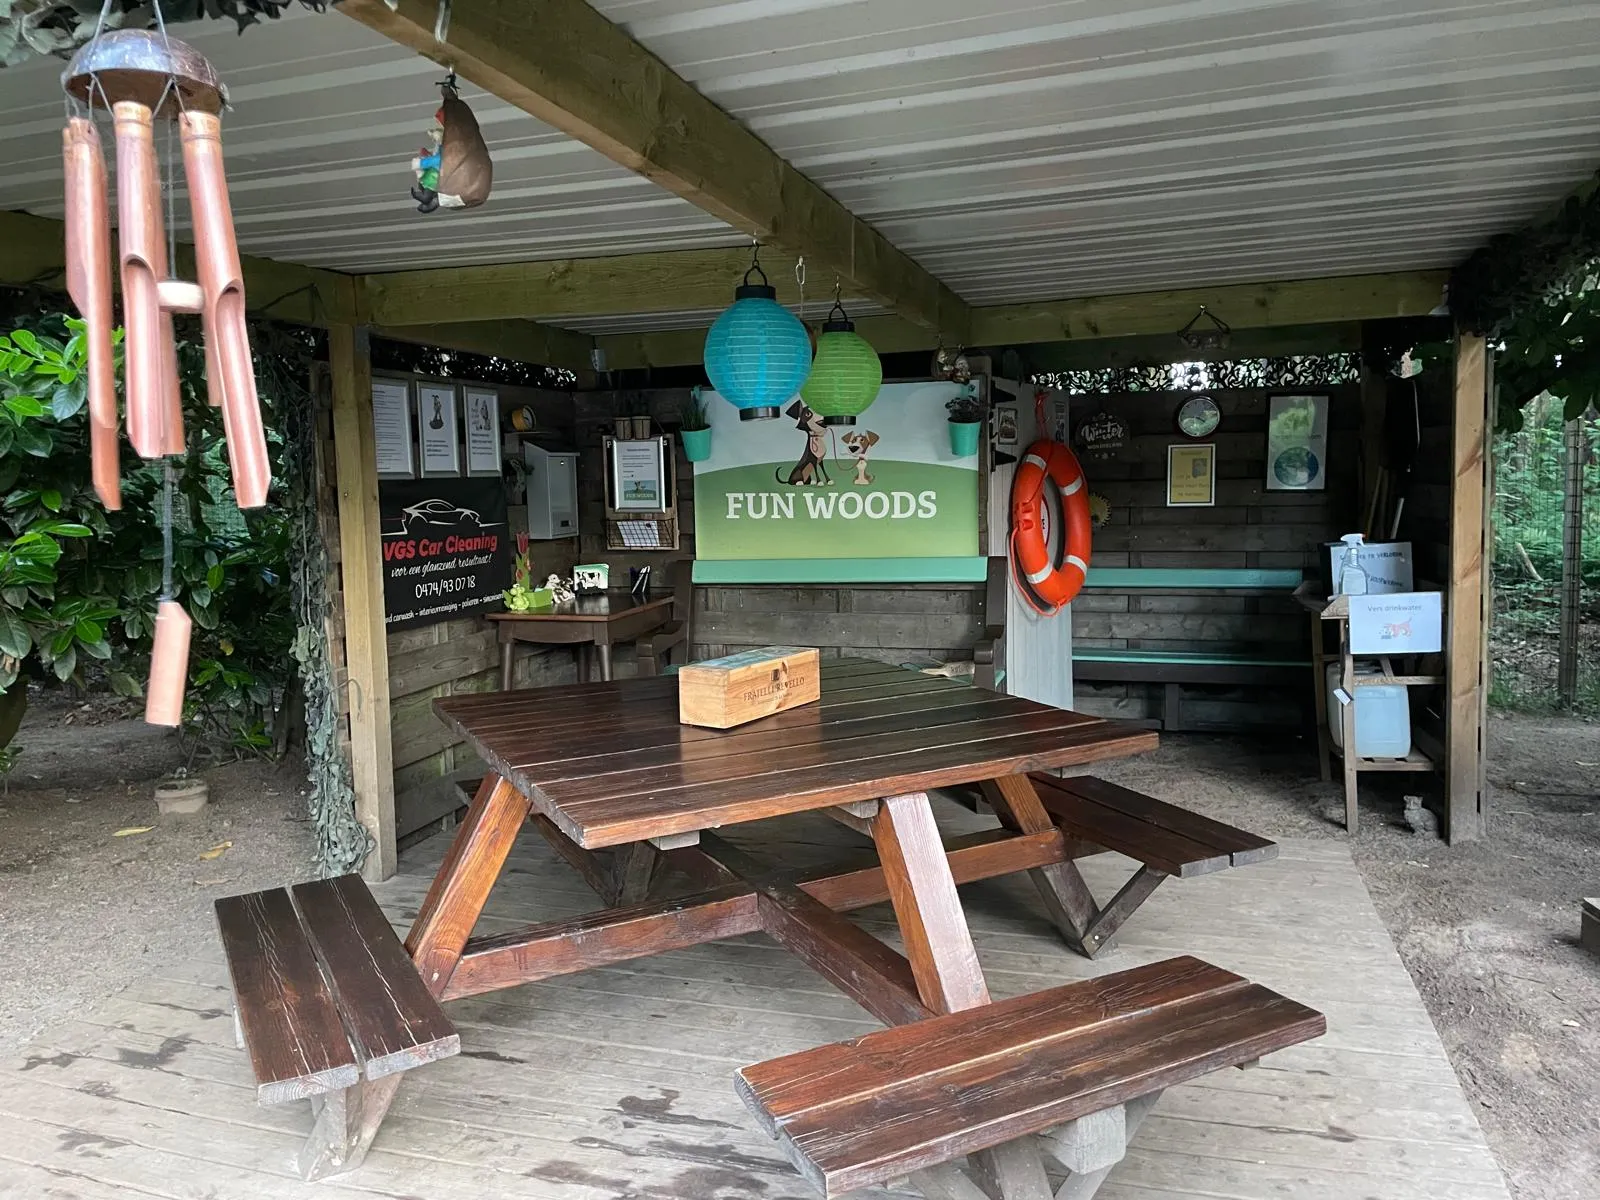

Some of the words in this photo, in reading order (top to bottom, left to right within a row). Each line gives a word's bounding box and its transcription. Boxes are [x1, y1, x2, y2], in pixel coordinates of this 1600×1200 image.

[726, 492, 795, 519] FUN
[803, 490, 937, 520] WOODS
[383, 540, 416, 561] VGS
[419, 539, 443, 557] Car
[445, 531, 498, 554] Cleaning
[391, 566, 408, 578] voor
[409, 564, 420, 575] een
[422, 557, 456, 577] glanzend
[415, 579, 454, 599] 0474/93
[455, 577, 466, 592] 07
[467, 575, 476, 589] 18
[743, 686, 775, 701] FRATELLI
